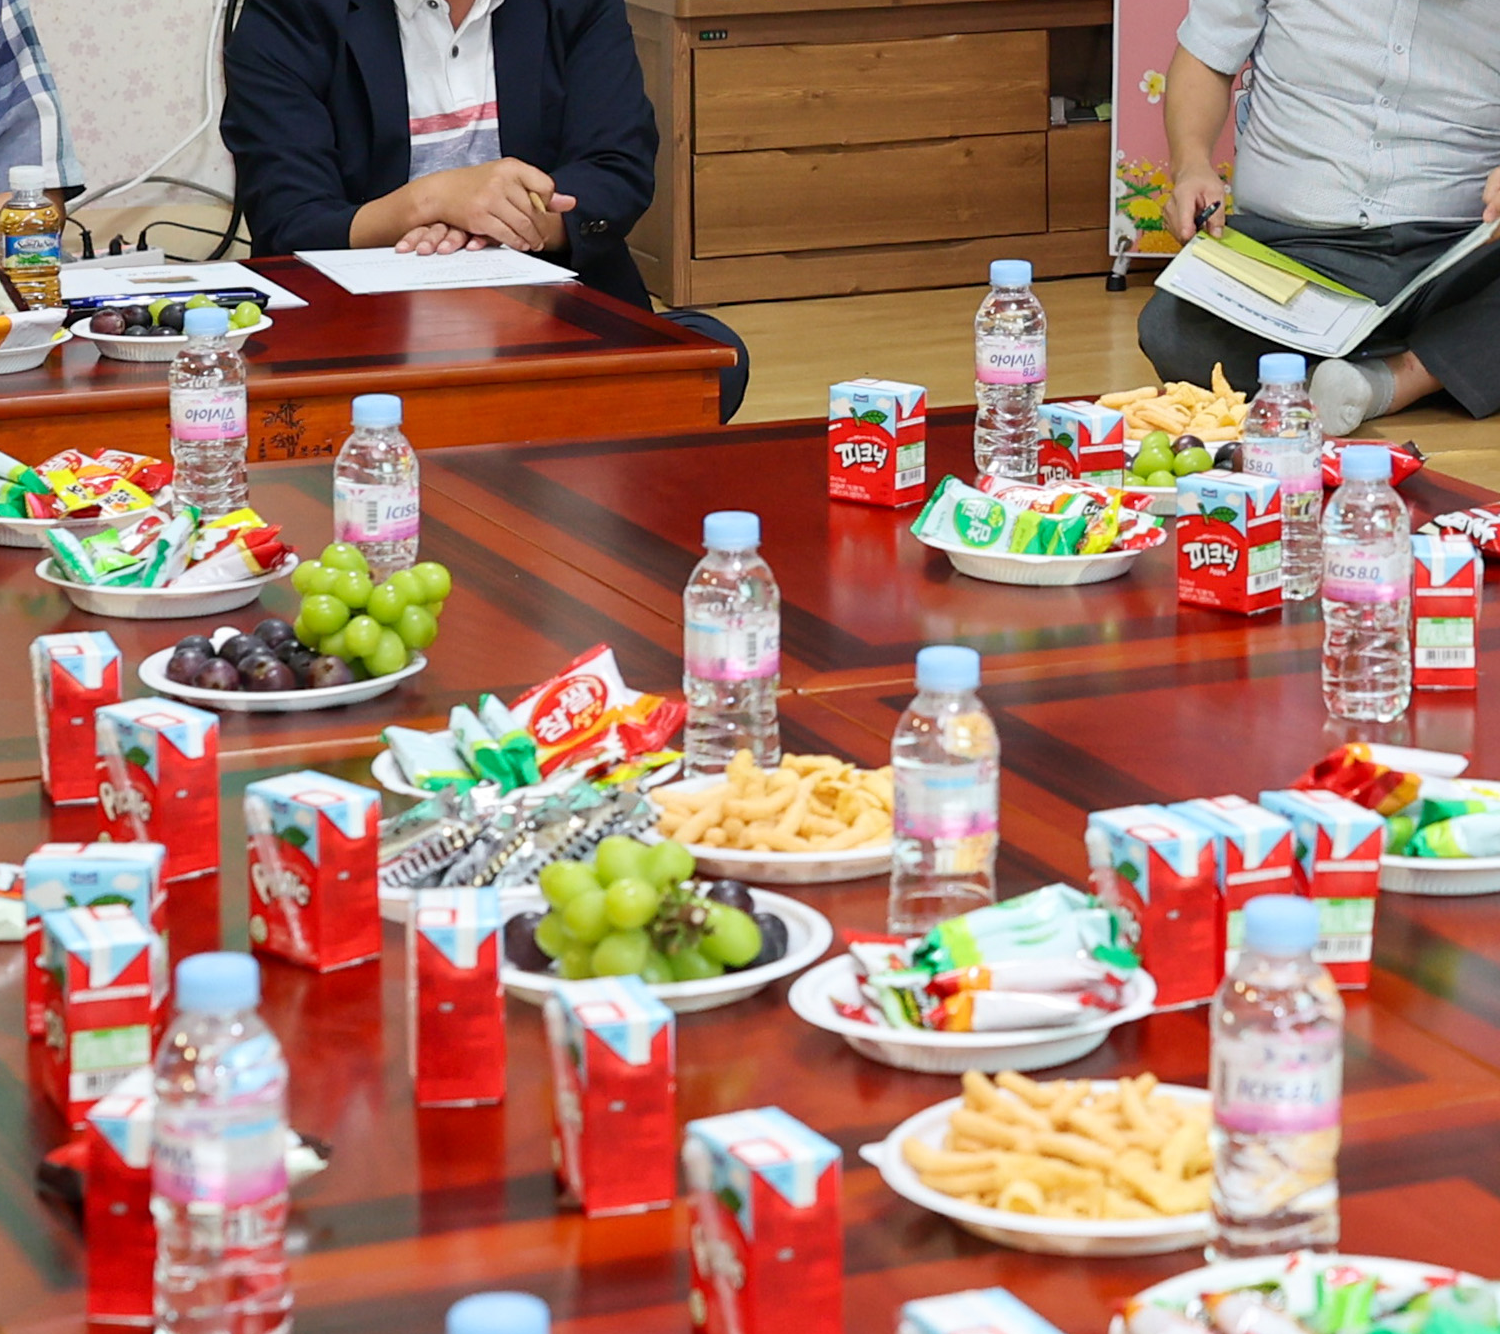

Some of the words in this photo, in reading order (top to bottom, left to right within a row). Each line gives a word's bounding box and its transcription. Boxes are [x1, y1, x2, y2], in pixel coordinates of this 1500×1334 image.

[990, 354, 1036, 367] 아이시스
[186, 406, 235, 422] 아이시스
[834, 443, 888, 468] 피크닉
[1182, 542, 1238, 571] 피크닉
